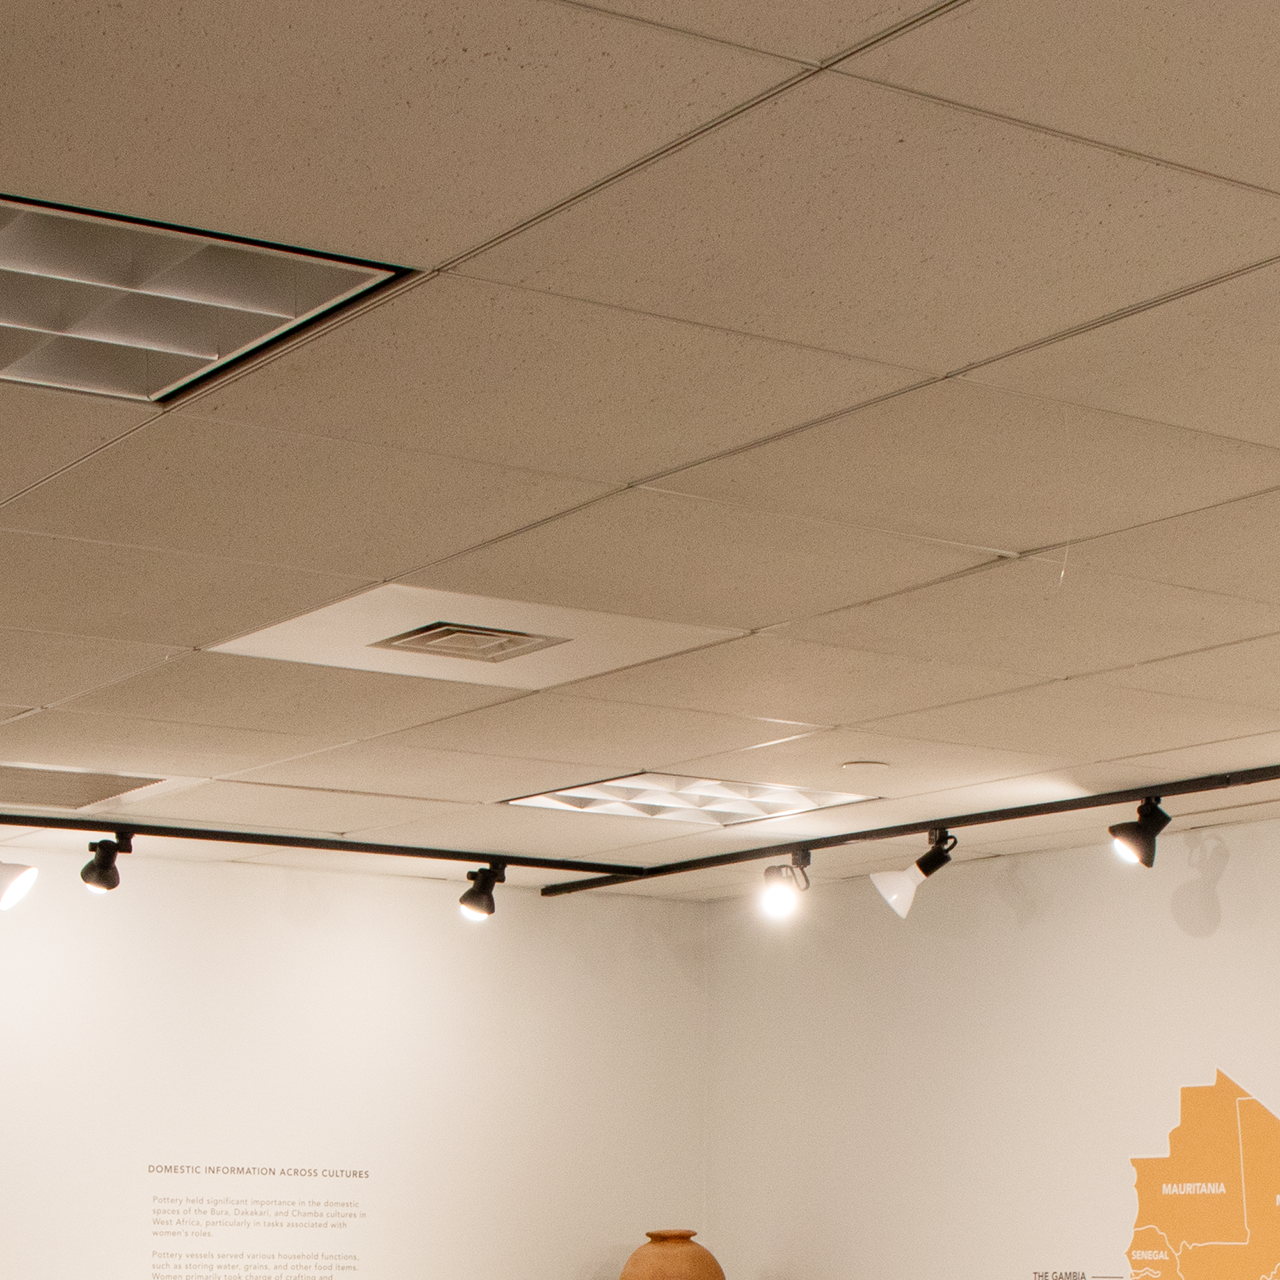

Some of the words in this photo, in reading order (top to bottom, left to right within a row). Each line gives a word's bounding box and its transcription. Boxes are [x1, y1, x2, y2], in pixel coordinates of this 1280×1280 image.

[148, 1164, 200, 1175] DOMESTIC
[204, 1166, 275, 1177] INFORMATION
[279, 1168, 318, 1178] ACROSS
[321, 1169, 370, 1179] CULTURES
[1162, 1183, 1225, 1194] MAURITANIA
[152, 1195, 183, 1206] Pottery
[185, 1196, 204, 1204] held
[206, 1196, 248, 1207] significant
[250, 1198, 296, 1208] importance
[298, 1198, 306, 1206] in
[308, 1198, 321, 1207] the
[323, 1198, 360, 1207] domestic
[152, 1209, 180, 1217] spaces
[182, 1207, 191, 1215] of
[193, 1207, 207, 1216] the
[274, 1208, 289, 1217] and
[291, 1208, 323, 1217] Chamba
[325, 1209, 357, 1218] cultures
[359, 1210, 367, 1218] in
[152, 1217, 172, 1226] West
[205, 1218, 250, 1229] particularly
[253, 1219, 260, 1227] in
[263, 1219, 283, 1227] tasks
[286, 1219, 328, 1228] associated
[330, 1220, 348, 1228] with
[152, 1228, 188, 1237] women's
[152, 1250, 182, 1261] Pottery
[185, 1250, 214, 1259] vessels
[216, 1250, 244, 1259] served
[246, 1251, 275, 1259] various
[277, 1251, 319, 1260] household
[1131, 1250, 1170, 1260] SENEGAL
[152, 1261, 170, 1270] such
[184, 1262, 213, 1272] storing
[273, 1262, 288, 1270] and
[290, 1262, 311, 1270] other
[314, 1262, 333, 1270] food
[152, 1272, 182, 1280] Women
[223, 1272, 242, 1280] took
[274, 1272, 282, 1280] of
[318, 1273, 333, 1280] and
[1033, 1272, 1048, 1280] THE
[1052, 1272, 1086, 1280] GAMBIA
